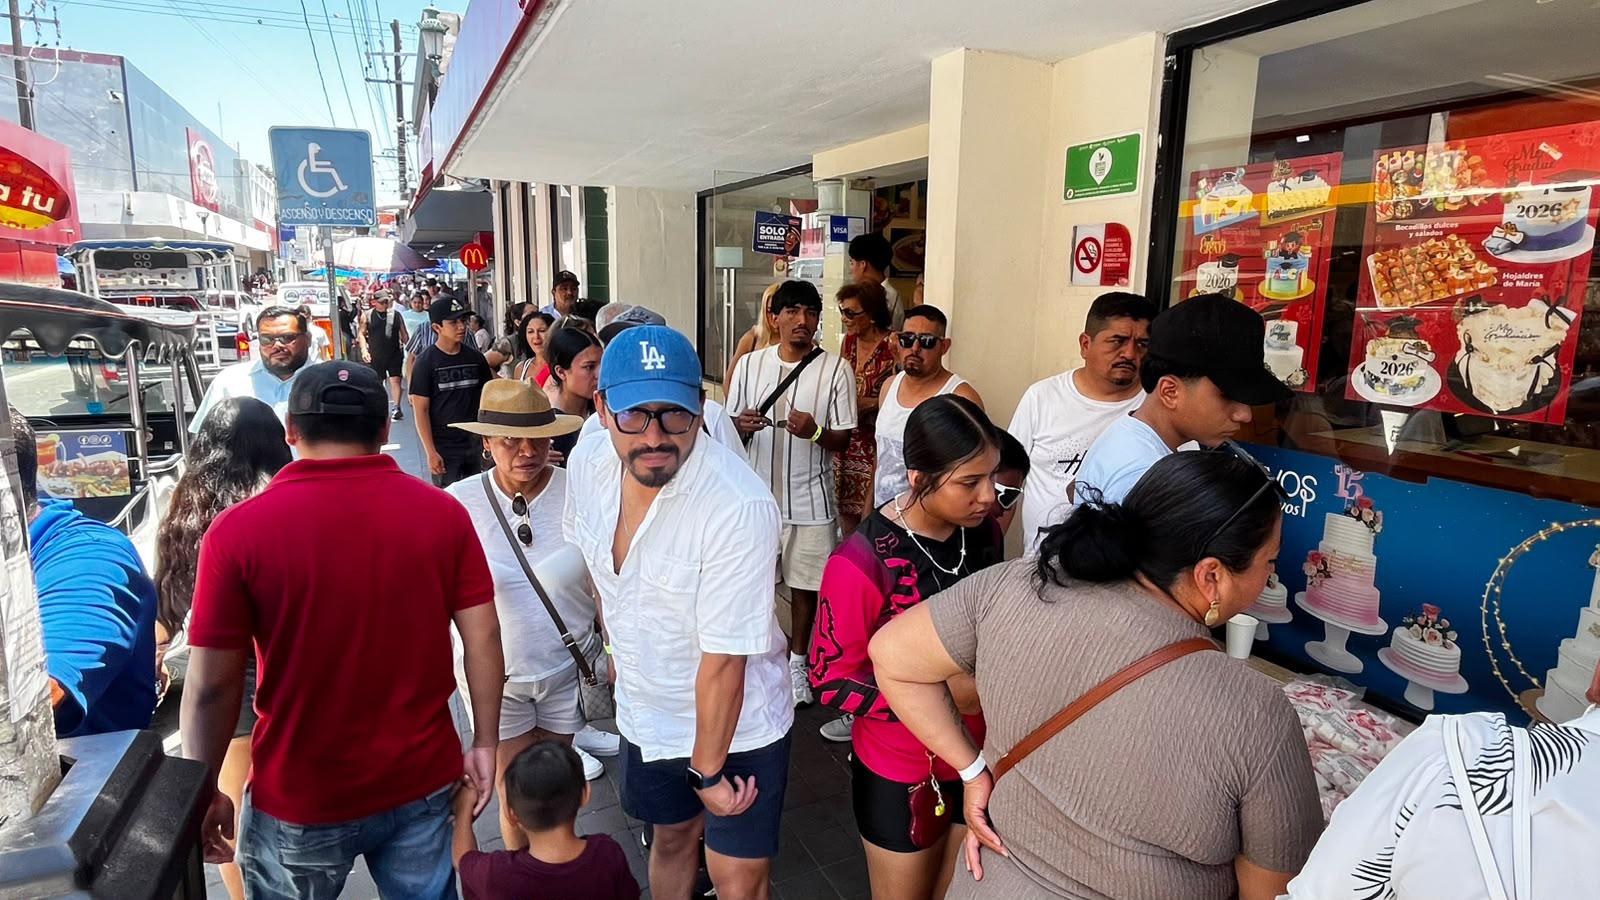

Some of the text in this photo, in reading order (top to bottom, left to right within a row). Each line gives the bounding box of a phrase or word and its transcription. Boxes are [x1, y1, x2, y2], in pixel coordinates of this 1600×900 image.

[21, 185, 55, 213] tu
[325, 207, 373, 220] DESCENSO
[1516, 202, 1562, 219] 2026
[759, 225, 786, 236] SOLO
[832, 226, 848, 234] VISA
[1395, 221, 1459, 231] Bocadillos dulces
[1205, 272, 1231, 289] 2026
[1502, 272, 1544, 281] Hojaldres
[640, 341, 666, 370] LA
[1380, 360, 1414, 376] 2026
